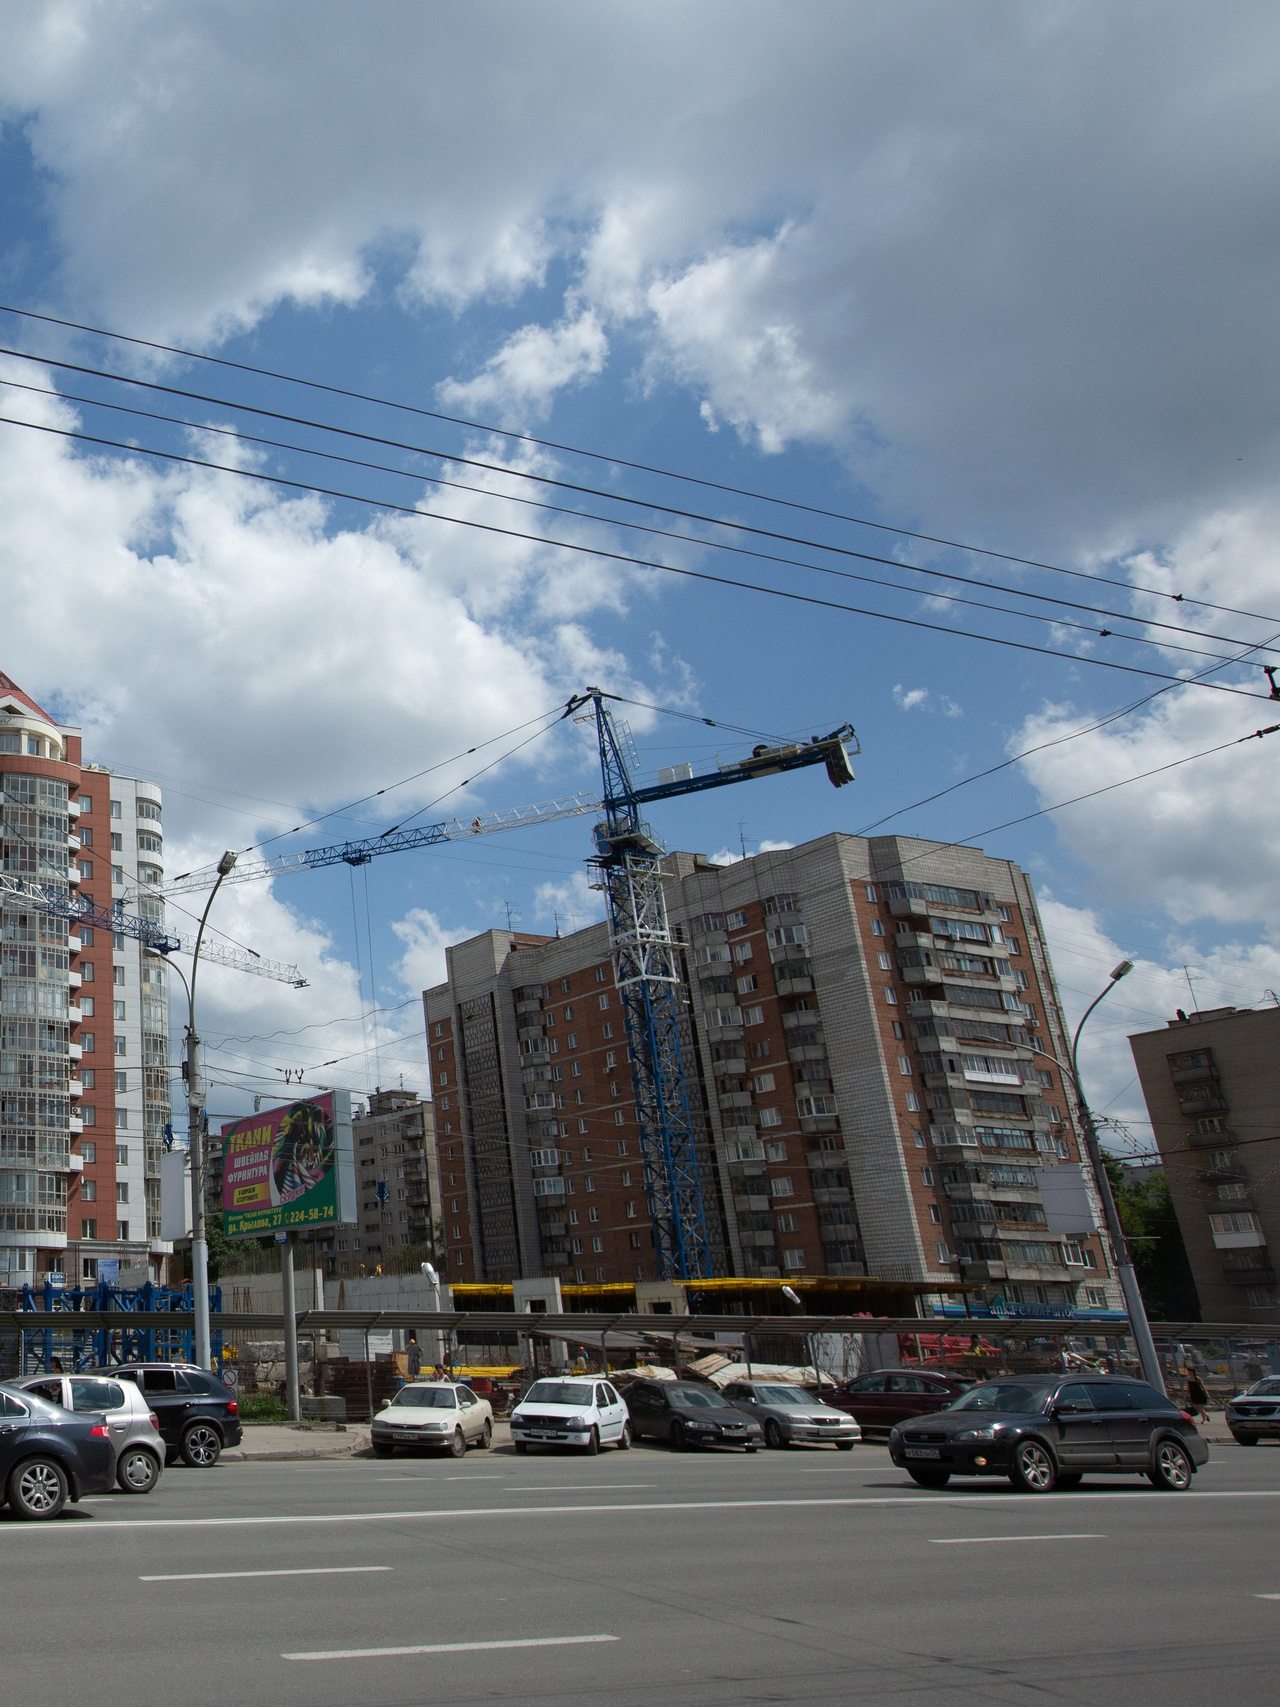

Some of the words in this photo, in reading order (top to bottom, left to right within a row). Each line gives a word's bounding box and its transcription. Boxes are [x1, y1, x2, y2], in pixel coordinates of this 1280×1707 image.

[230, 1125, 272, 1154] ТКАНИ
[234, 1150, 269, 1169] ШВЕЙНАЯ
[227, 1165, 268, 1184] ФУРНИТУРА
[273, 1214, 282, 1225] 27
[290, 1205, 334, 1223] 224-58-74
[989, 1301, 1016, 1315] anka
